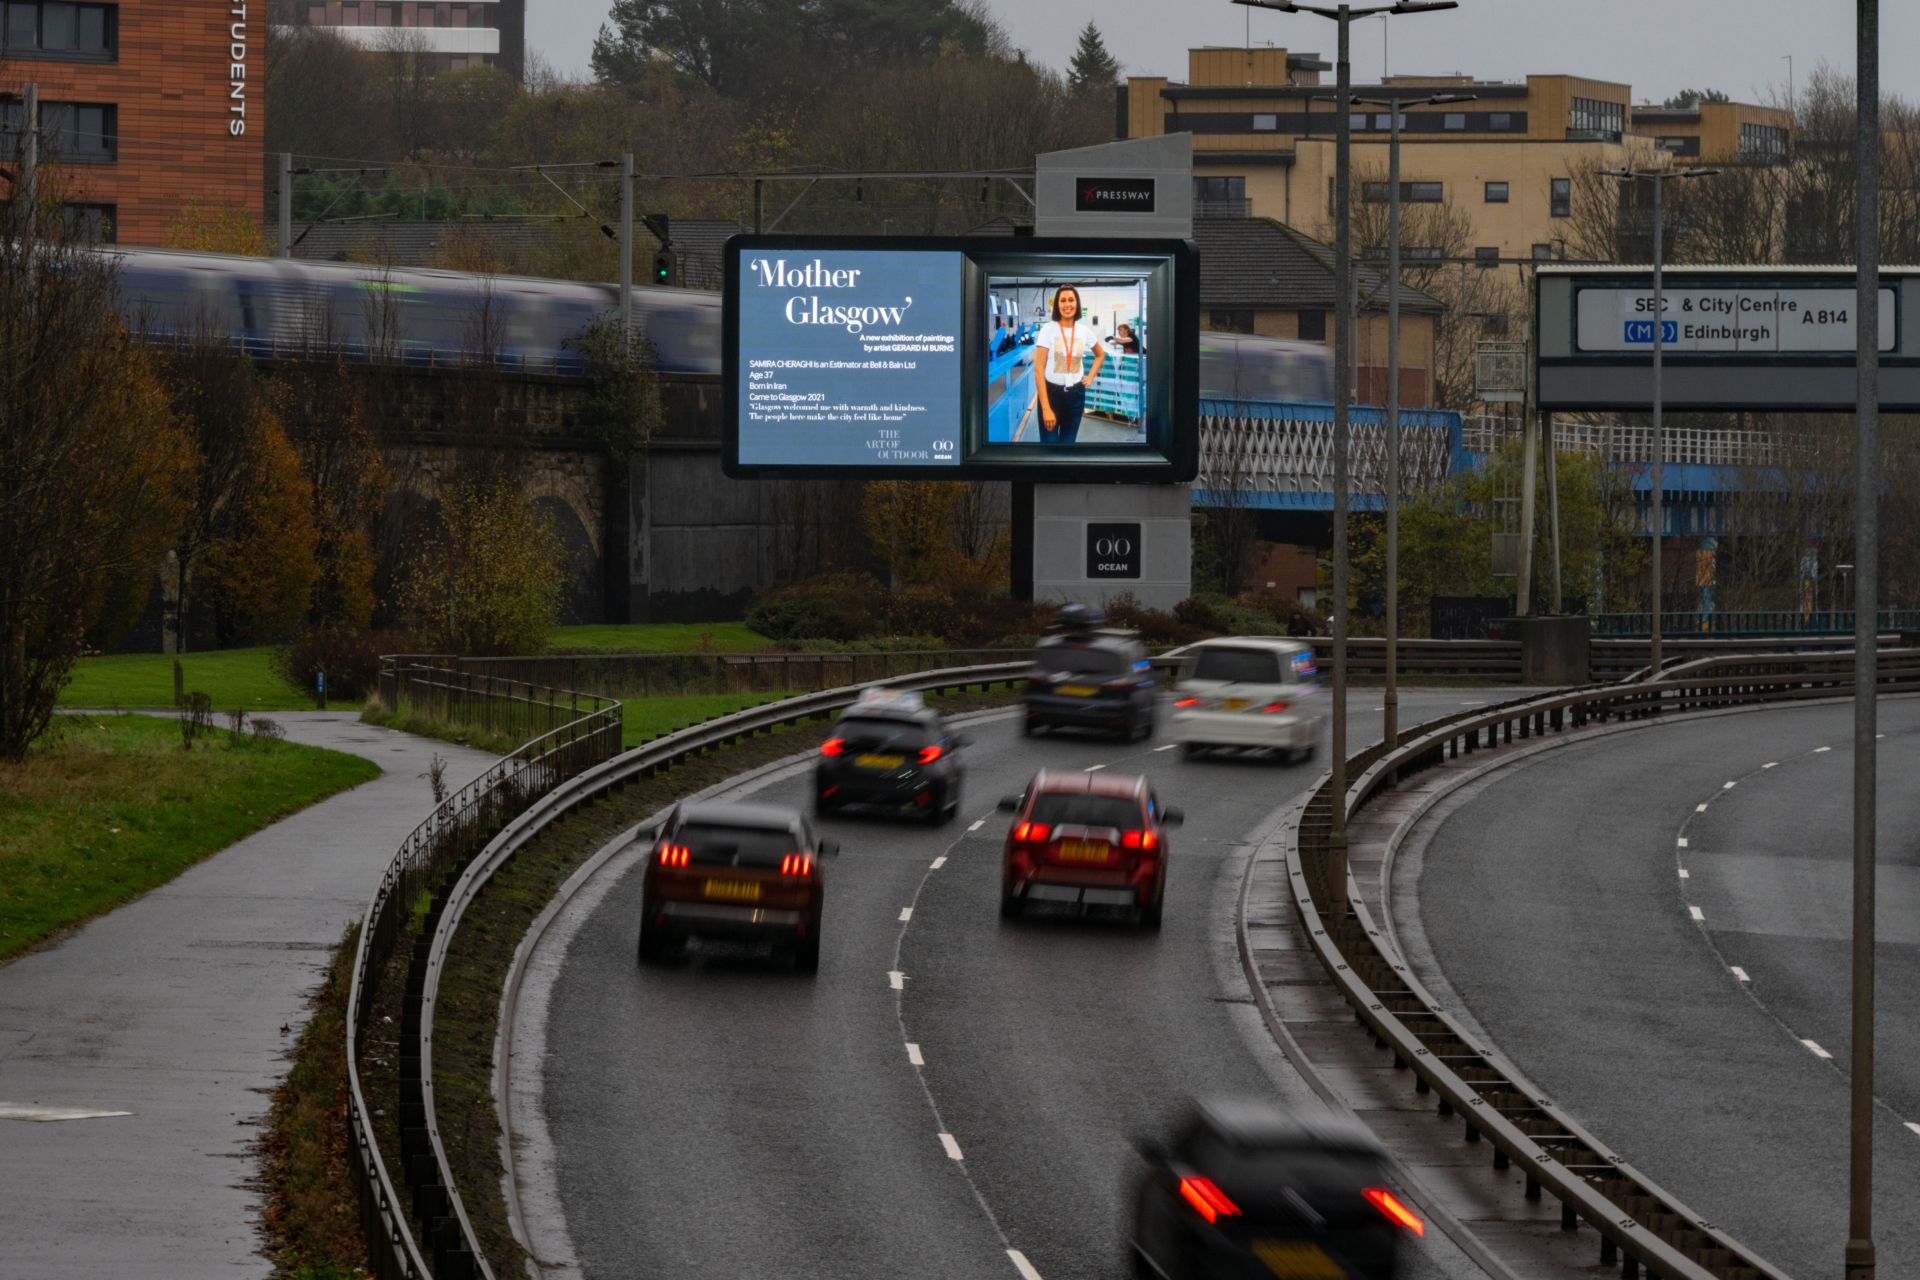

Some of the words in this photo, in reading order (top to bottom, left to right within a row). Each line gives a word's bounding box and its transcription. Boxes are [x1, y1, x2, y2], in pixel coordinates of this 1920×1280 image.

[230, 0, 246, 135] TUDENTS
[751, 259, 861, 288] ‘Mother
[1682, 298, 1693, 312] &
[1699, 298, 1733, 314] City
[1739, 298, 1797, 312] Centre
[785, 296, 912, 334] Glasgow’
[1684, 325, 1770, 342] Edinburgh
[923, 334, 954, 343] paintings
[864, 344, 873, 353] by
[892, 344, 921, 352] GERARD
[749, 360, 776, 368] SAMIRA
[777, 360, 813, 368] CHERAGHI
[813, 360, 819, 368] is
[870, 361, 882, 369] Bell
[882, 361, 888, 369] &
[889, 361, 903, 369] Bain
[904, 361, 916, 369] Ltd
[749, 371, 763, 380] Age
[764, 371, 773, 379] 37
[749, 382, 765, 390] Born
[766, 382, 773, 390] in
[774, 382, 787, 390] Iran
[749, 393, 769, 401] Came
[778, 393, 807, 402] Glasgow
[808, 393, 825, 401] 2021
[783, 403, 818, 411] welcomed
[833, 403, 849, 411] with
[850, 403, 878, 411] warmth
[749, 412, 763, 420] The
[765, 413, 788, 422] people
[789, 412, 805, 420] here
[839, 413, 852, 422] city
[879, 429, 900, 438] THE
[864, 440, 886, 449] ART
[886, 440, 900, 449] OF
[878, 450, 928, 459] OUTDOOR
[1098, 563, 1128, 571] OCEAN
